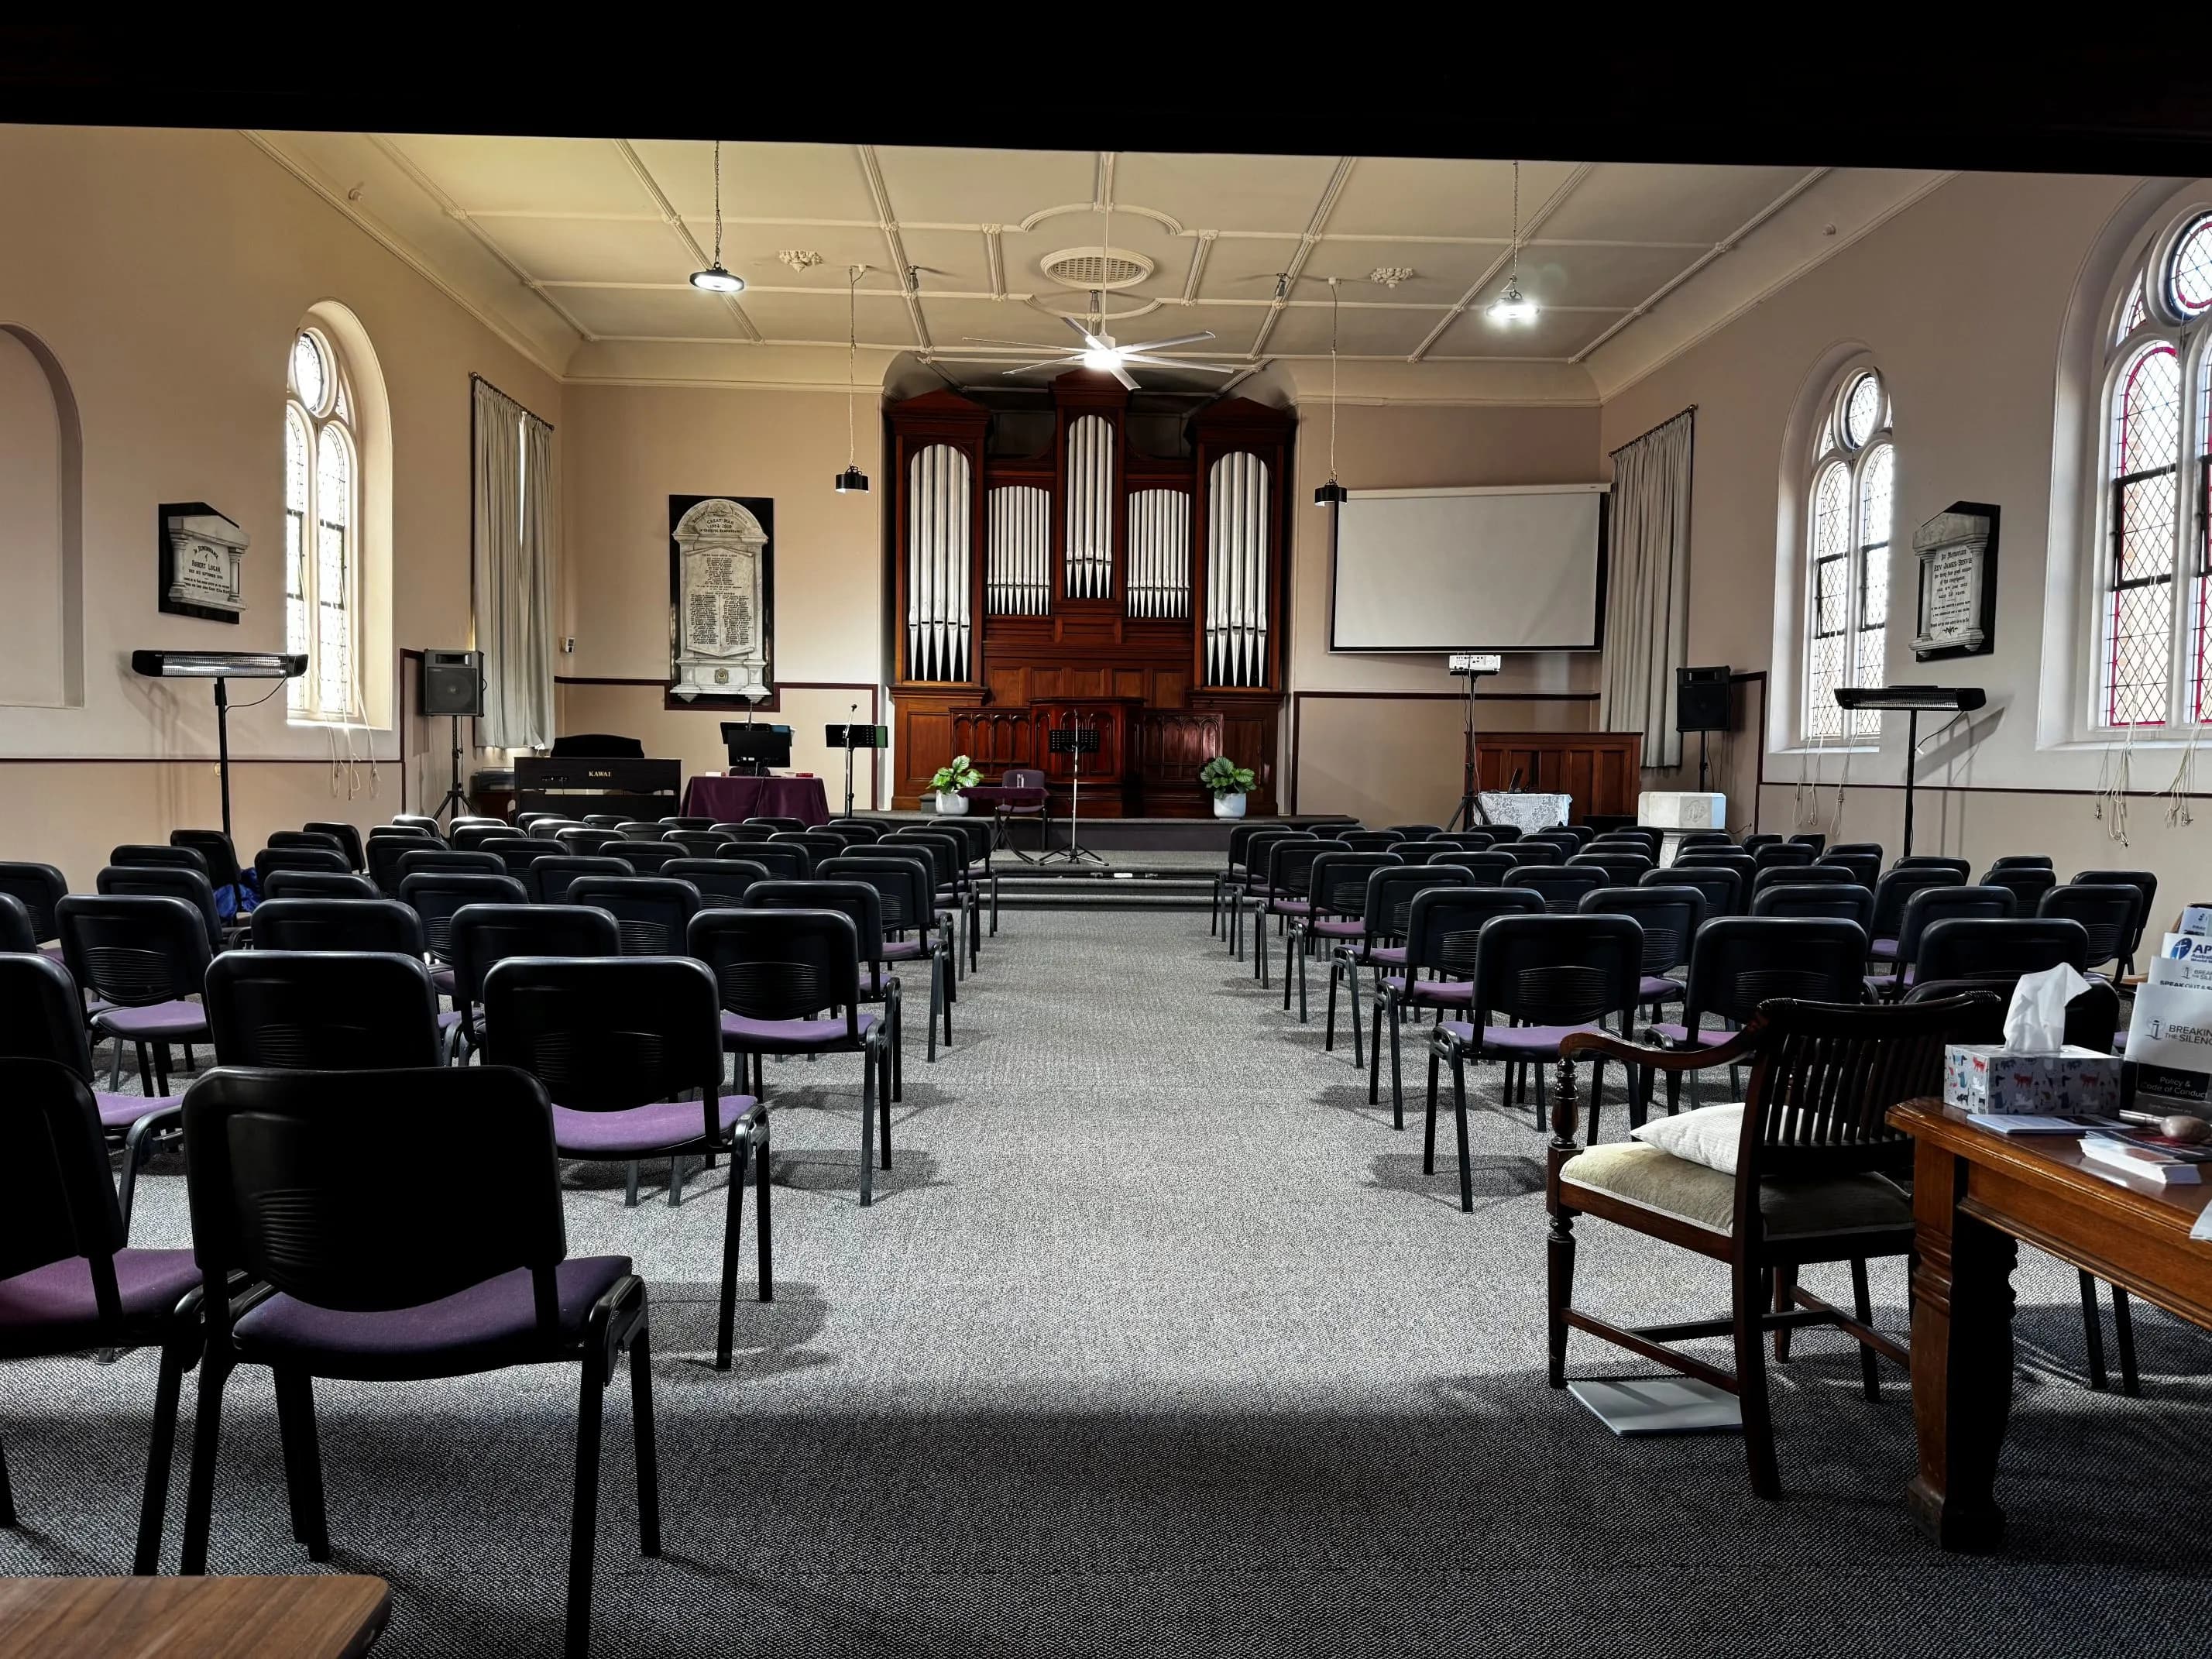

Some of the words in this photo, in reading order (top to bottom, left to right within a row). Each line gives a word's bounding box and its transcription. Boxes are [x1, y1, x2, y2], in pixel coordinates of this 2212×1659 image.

[192, 560, 206, 568] ROBERT
[208, 564, 221, 572] LOGAN
[2159, 1077, 2183, 1087] Policy
